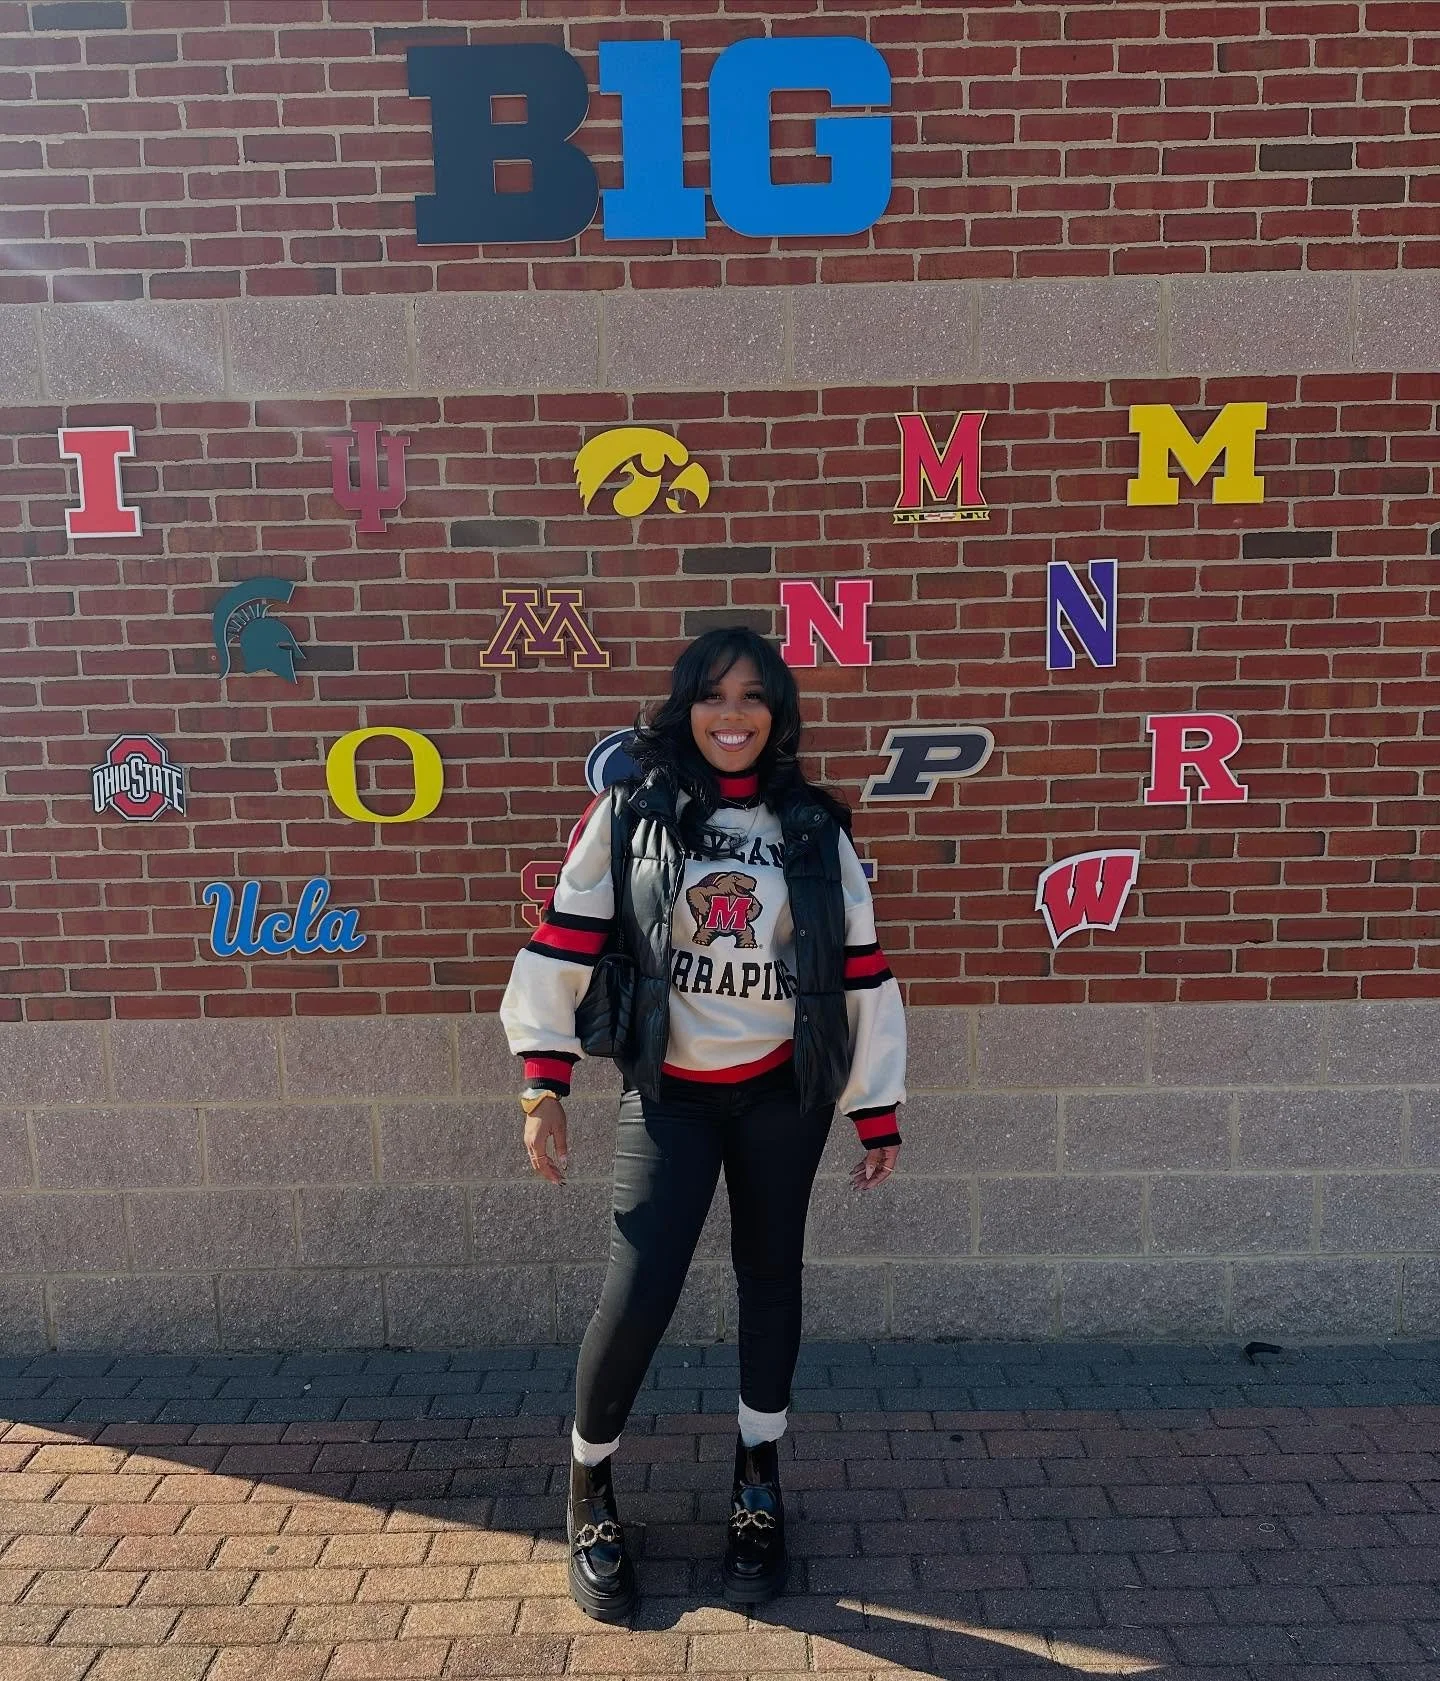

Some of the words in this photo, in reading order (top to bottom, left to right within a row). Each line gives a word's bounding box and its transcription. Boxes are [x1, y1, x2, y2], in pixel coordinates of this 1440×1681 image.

[58, 426, 142, 538] I
[893, 410, 988, 511] M
[1127, 402, 1268, 506] M
[480, 589, 610, 668] M
[780, 579, 873, 668] N
[1046, 559, 1118, 670] N
[326, 726, 444, 823] O
[861, 727, 995, 802] P
[1144, 713, 1249, 805] R
[203, 877, 367, 957] Ucla
[705, 895, 753, 930] M
[1035, 849, 1140, 949] W
